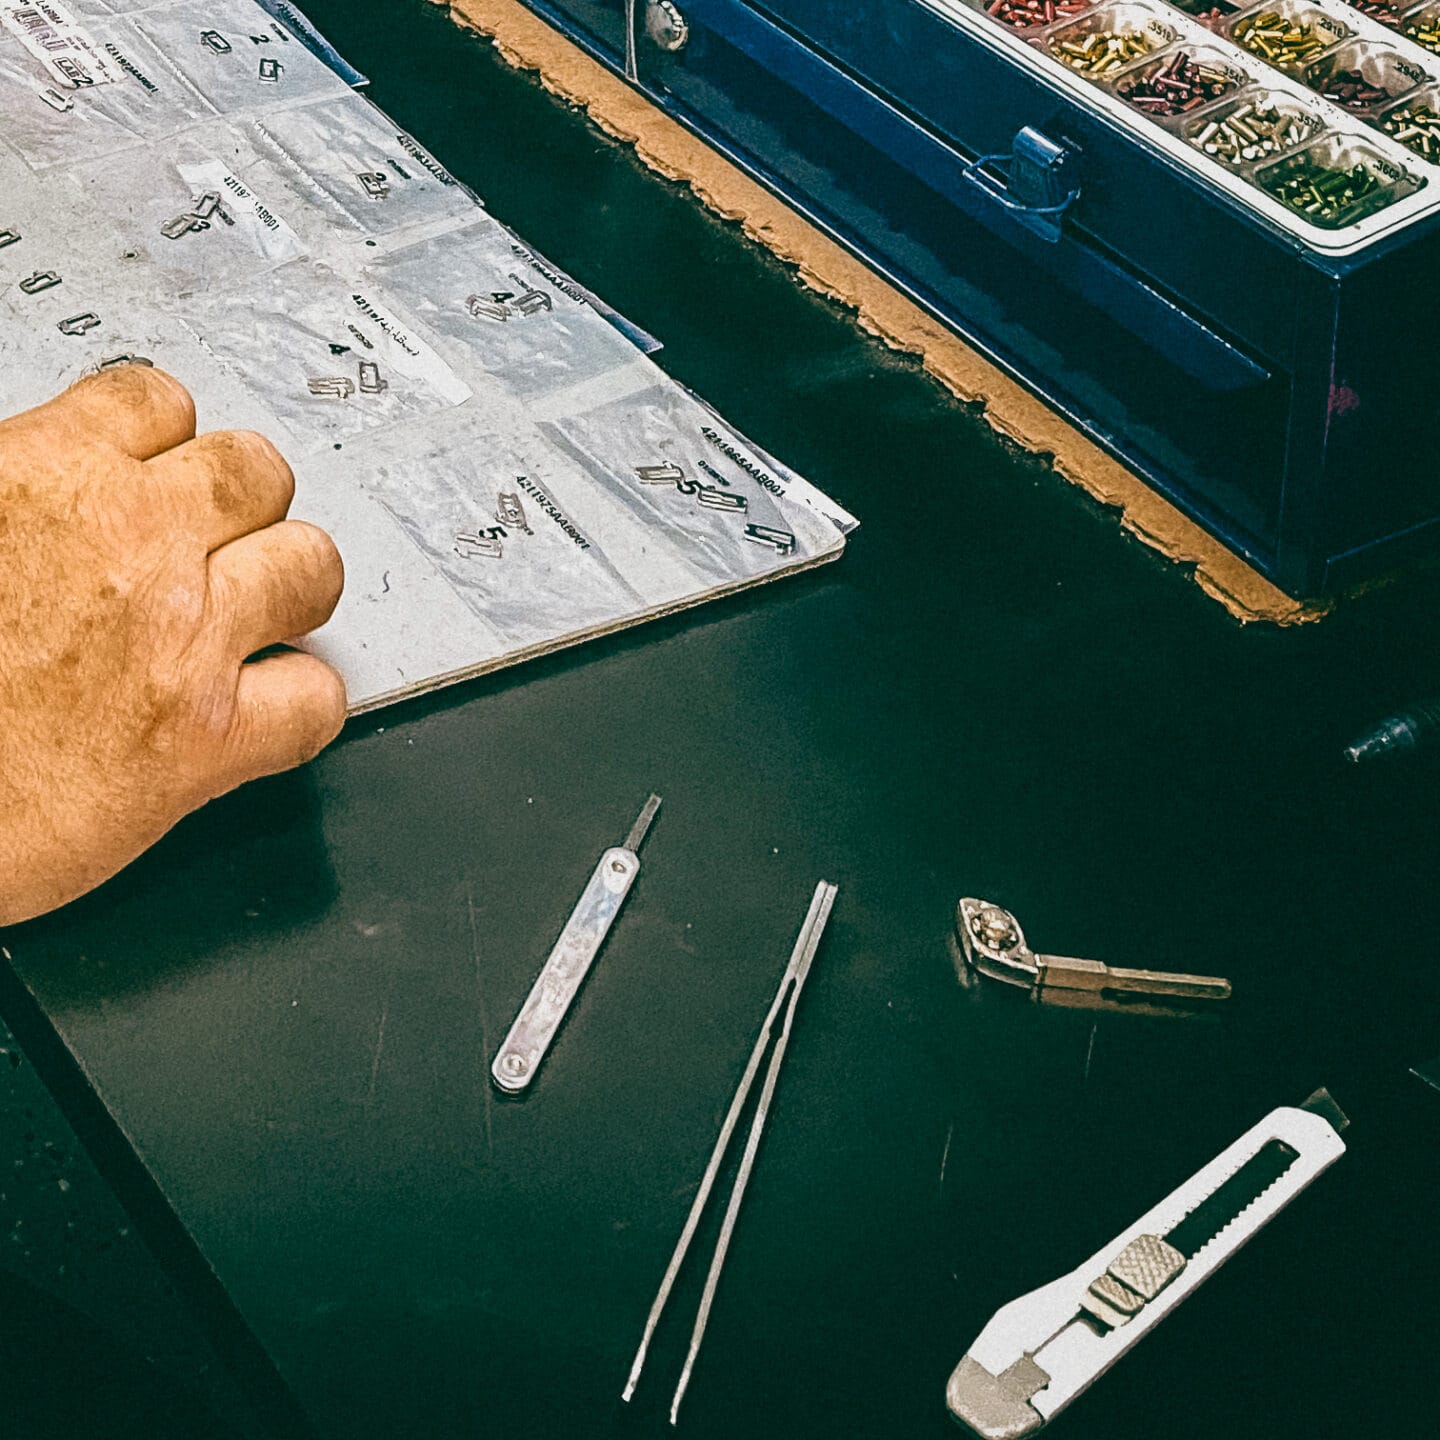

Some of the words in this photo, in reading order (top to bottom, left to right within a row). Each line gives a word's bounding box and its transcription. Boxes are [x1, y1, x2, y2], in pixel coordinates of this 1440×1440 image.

[491, 292, 515, 303] 4
[328, 343, 351, 356] 4
[701, 426, 786, 497] 4211965AAB001
[479, 526, 508, 540] 5
